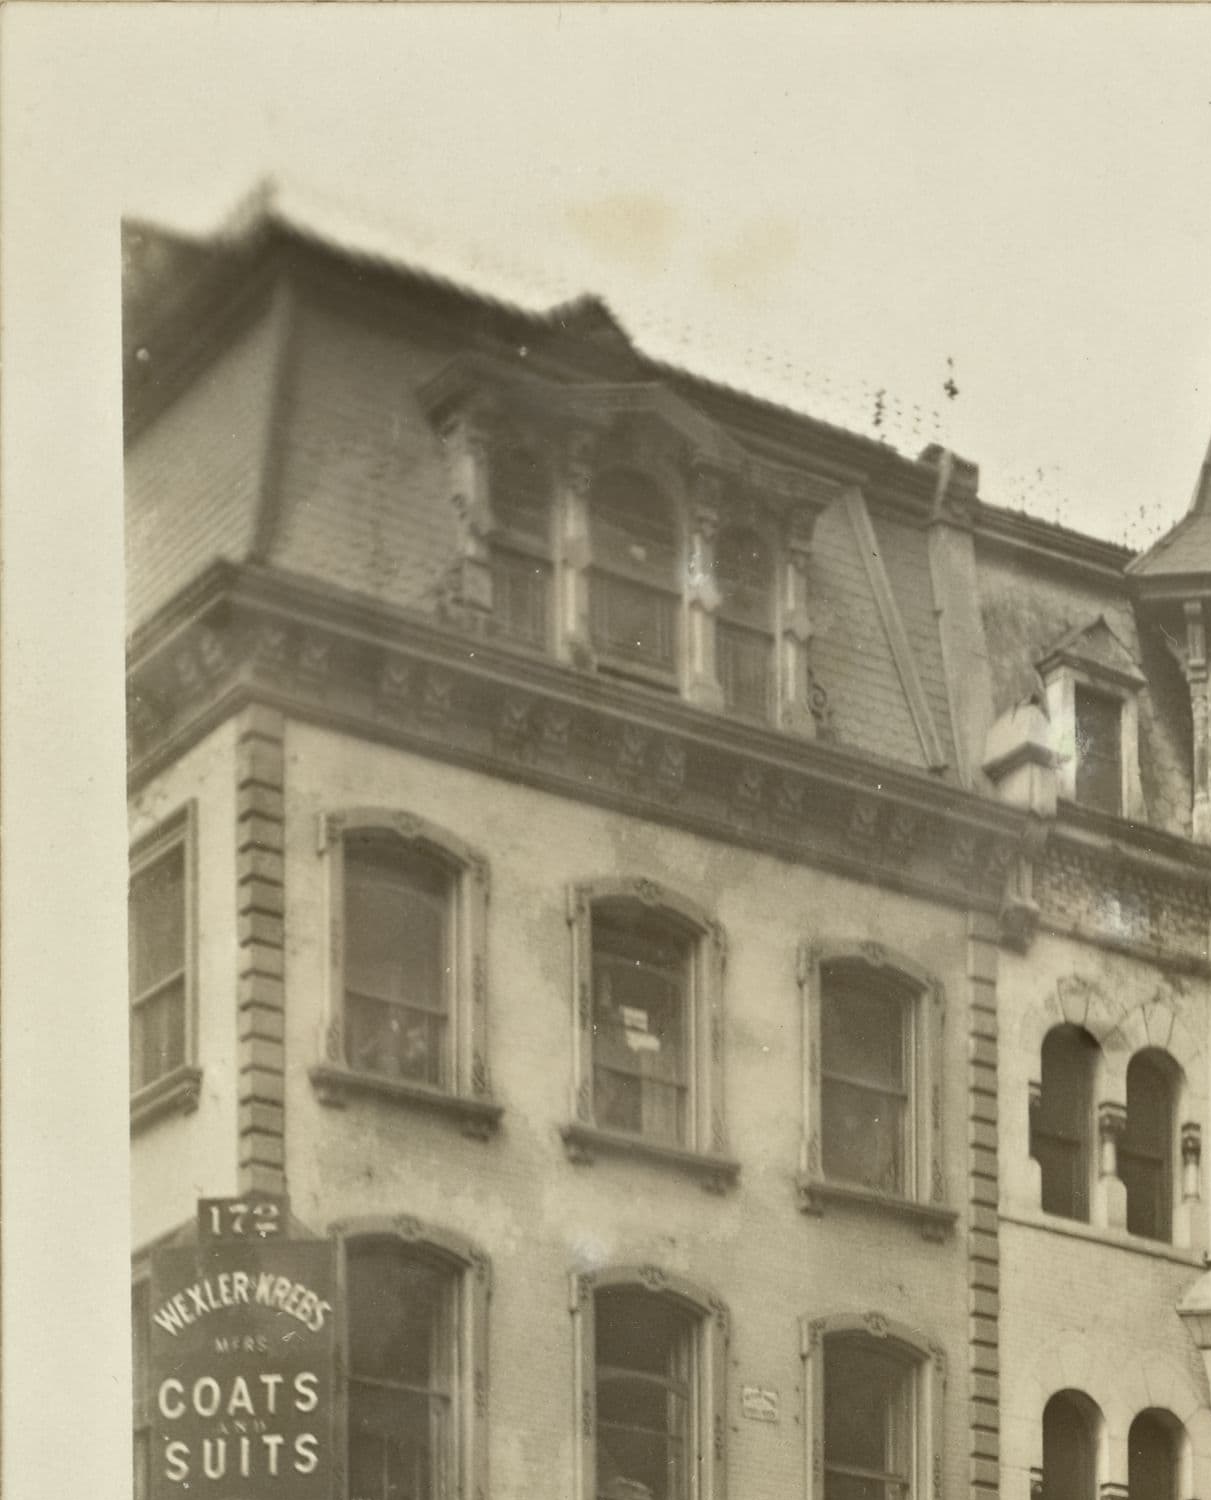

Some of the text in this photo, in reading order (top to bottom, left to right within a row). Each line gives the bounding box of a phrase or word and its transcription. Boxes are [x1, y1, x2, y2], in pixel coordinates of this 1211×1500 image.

[154, 1271, 249, 1336] WEXLER
[255, 1271, 332, 1332] KREBS
[158, 1372, 319, 1419] COATS
[165, 1433, 319, 1481] SUITS
